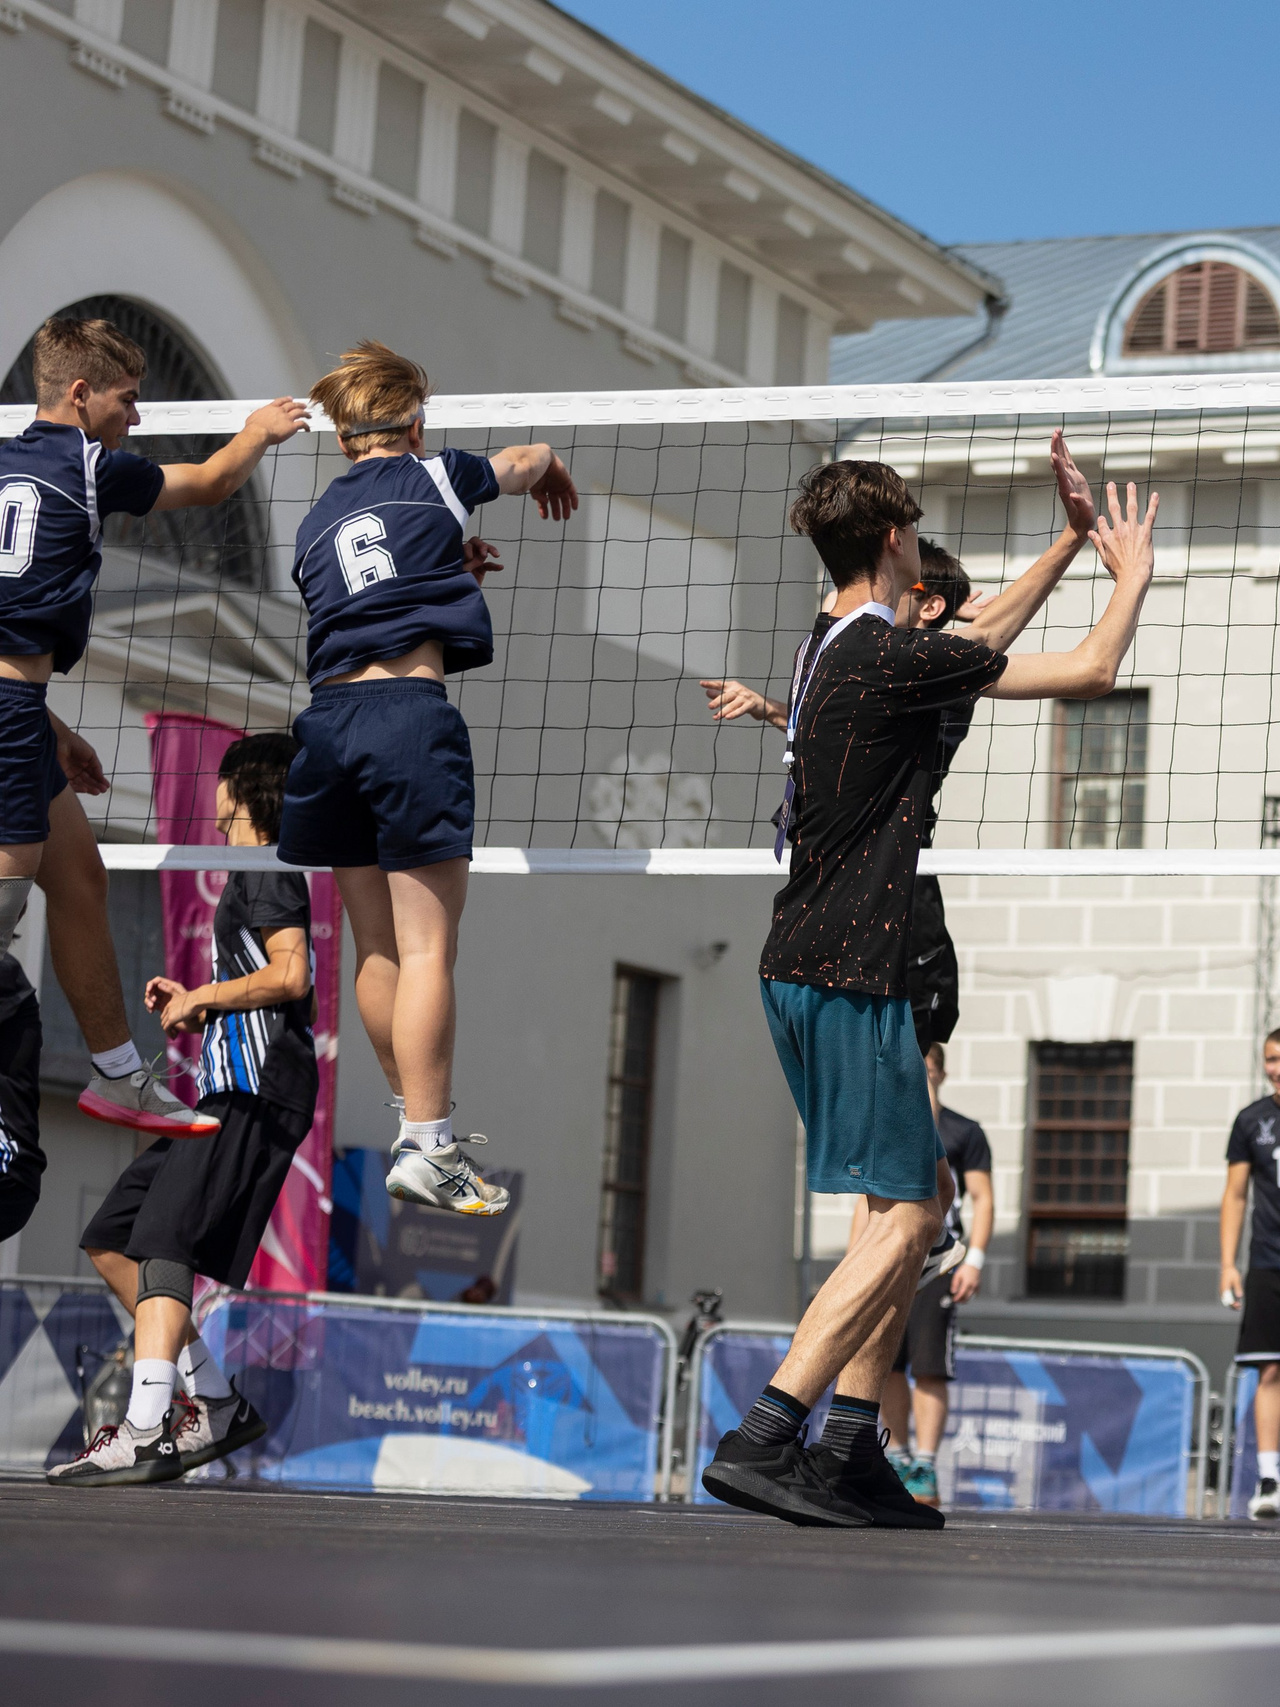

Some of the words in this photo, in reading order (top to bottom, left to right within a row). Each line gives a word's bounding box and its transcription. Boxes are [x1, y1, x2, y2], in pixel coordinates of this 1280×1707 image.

[334, 512, 398, 596] 6
[384, 1368, 468, 1397] volley.ru
[349, 1395, 498, 1431] beach.volley.ru
